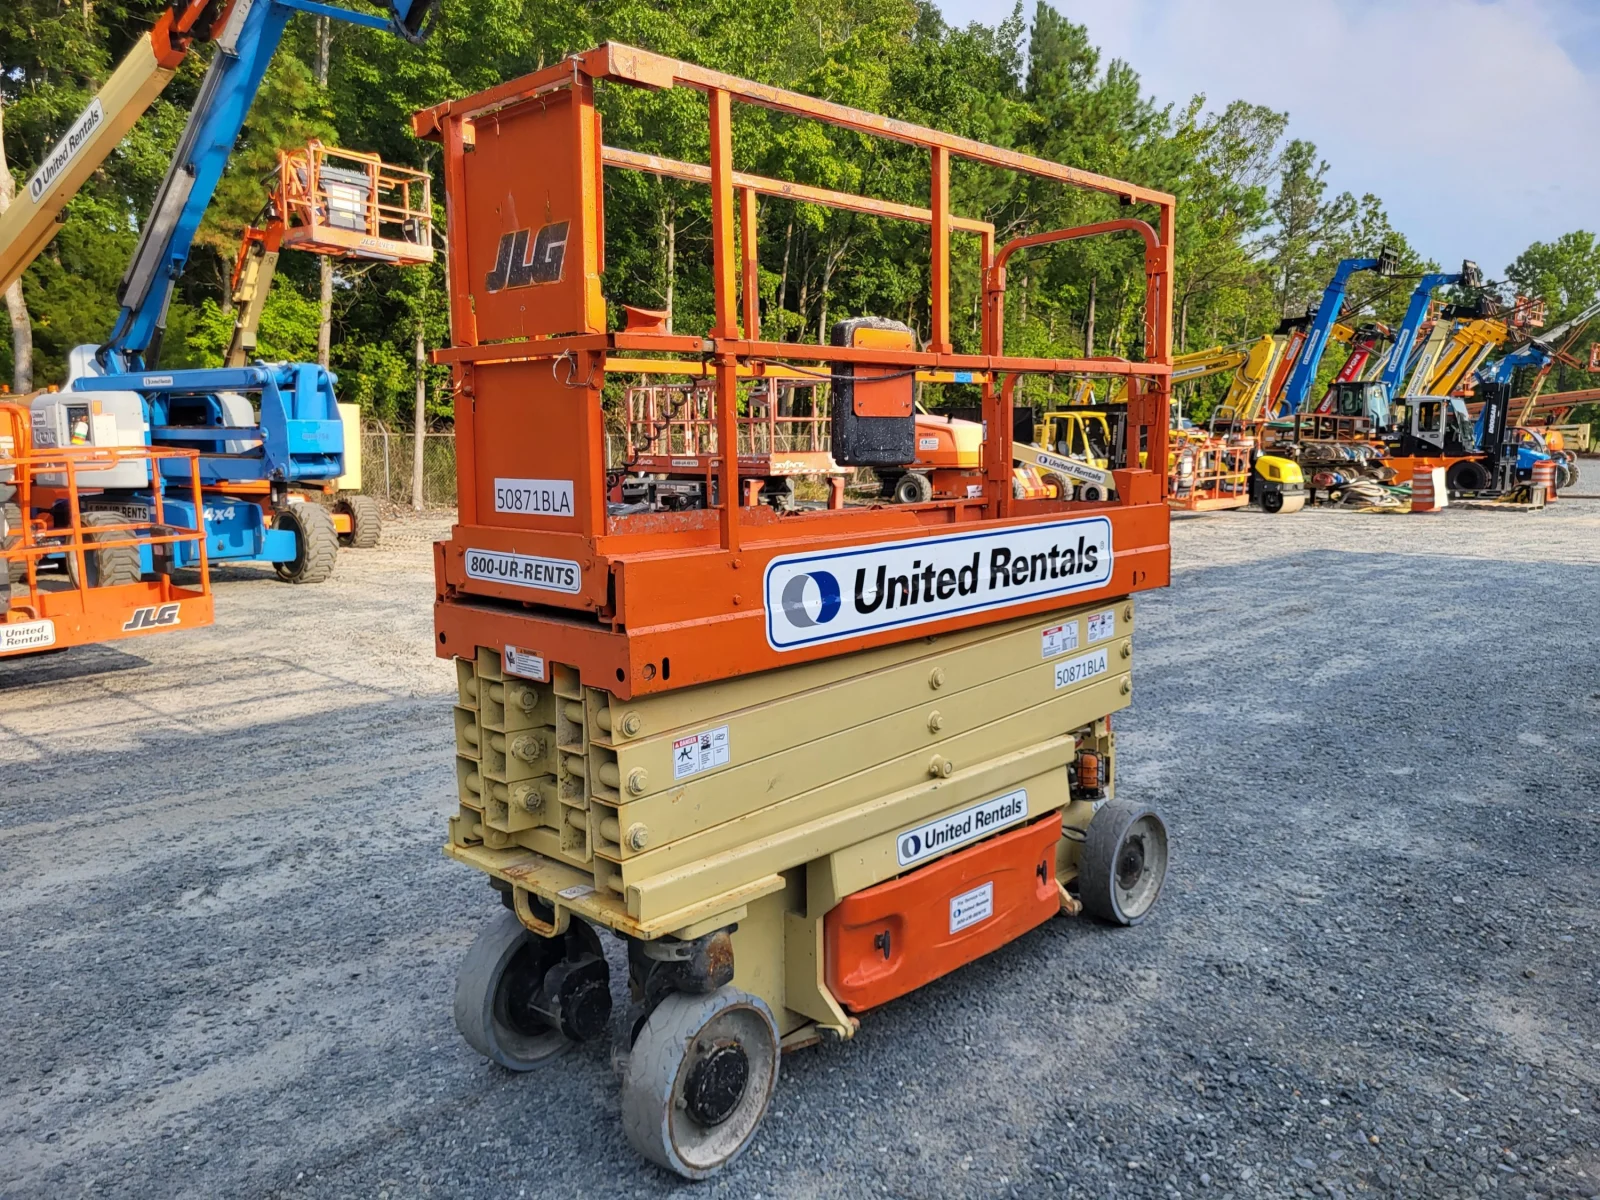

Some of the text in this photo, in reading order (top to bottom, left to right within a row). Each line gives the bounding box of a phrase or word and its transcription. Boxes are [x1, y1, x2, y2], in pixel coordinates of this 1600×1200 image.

[42, 110, 99, 184] United Rentals
[361, 238, 376, 246] JLG
[486, 220, 571, 292] JLG
[1488, 404, 1497, 434] DOOSAN
[1049, 459, 1102, 481] United Rentals
[204, 506, 236, 521] 4x4
[497, 488, 571, 513] 50871BLA
[471, 556, 575, 586] 800-UR-RENTS
[854, 536, 1098, 615] United Rentals
[124, 605, 180, 630] JLG
[5, 625, 45, 638] United
[6, 634, 50, 647] Rentals
[1056, 656, 1106, 687] 50871BLA
[925, 798, 1022, 849] United Rentals
